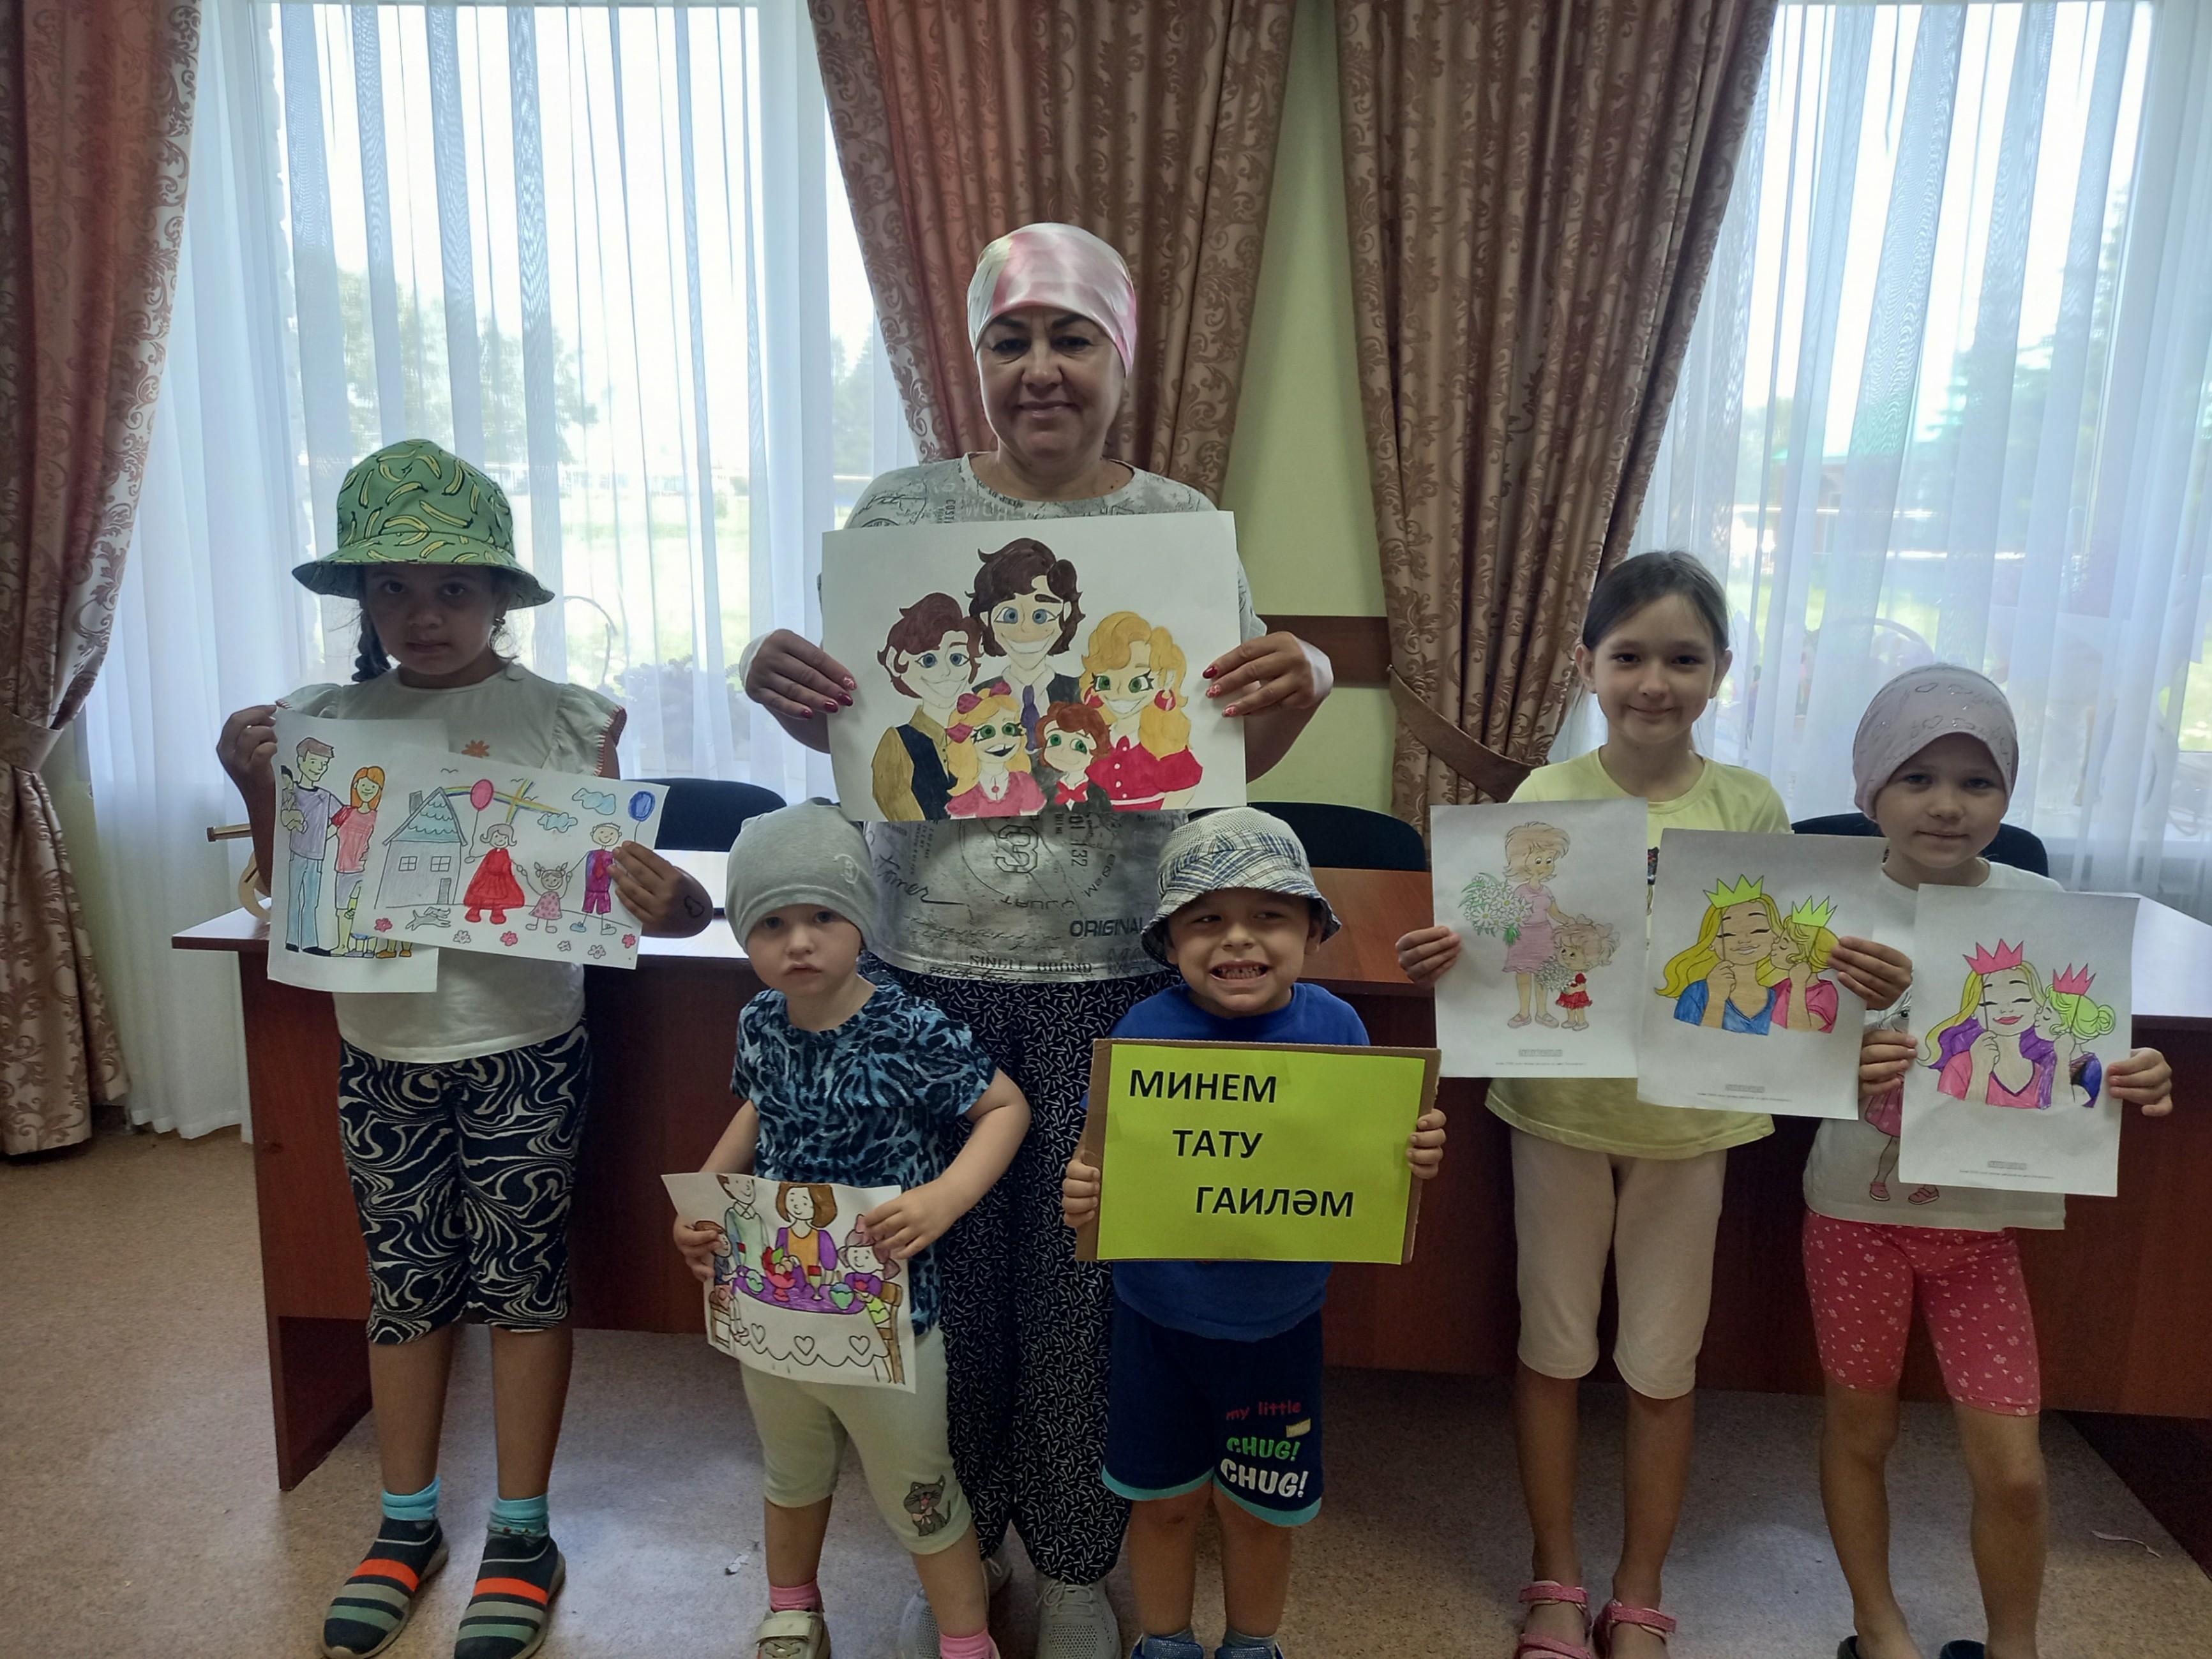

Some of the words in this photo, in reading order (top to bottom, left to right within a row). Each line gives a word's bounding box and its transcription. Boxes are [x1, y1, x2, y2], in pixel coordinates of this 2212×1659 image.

[1129, 1069, 1277, 1103] МИНЕМ
[1172, 1129, 1263, 1159] ТАТУ
[1196, 1187, 1354, 1218] ГАИЛӘМ
[1225, 1406, 1251, 1420] my
[1258, 1399, 1302, 1416] little
[1226, 1437, 1301, 1461] CHUG!
[1220, 1458, 1309, 1498] CHUG!
